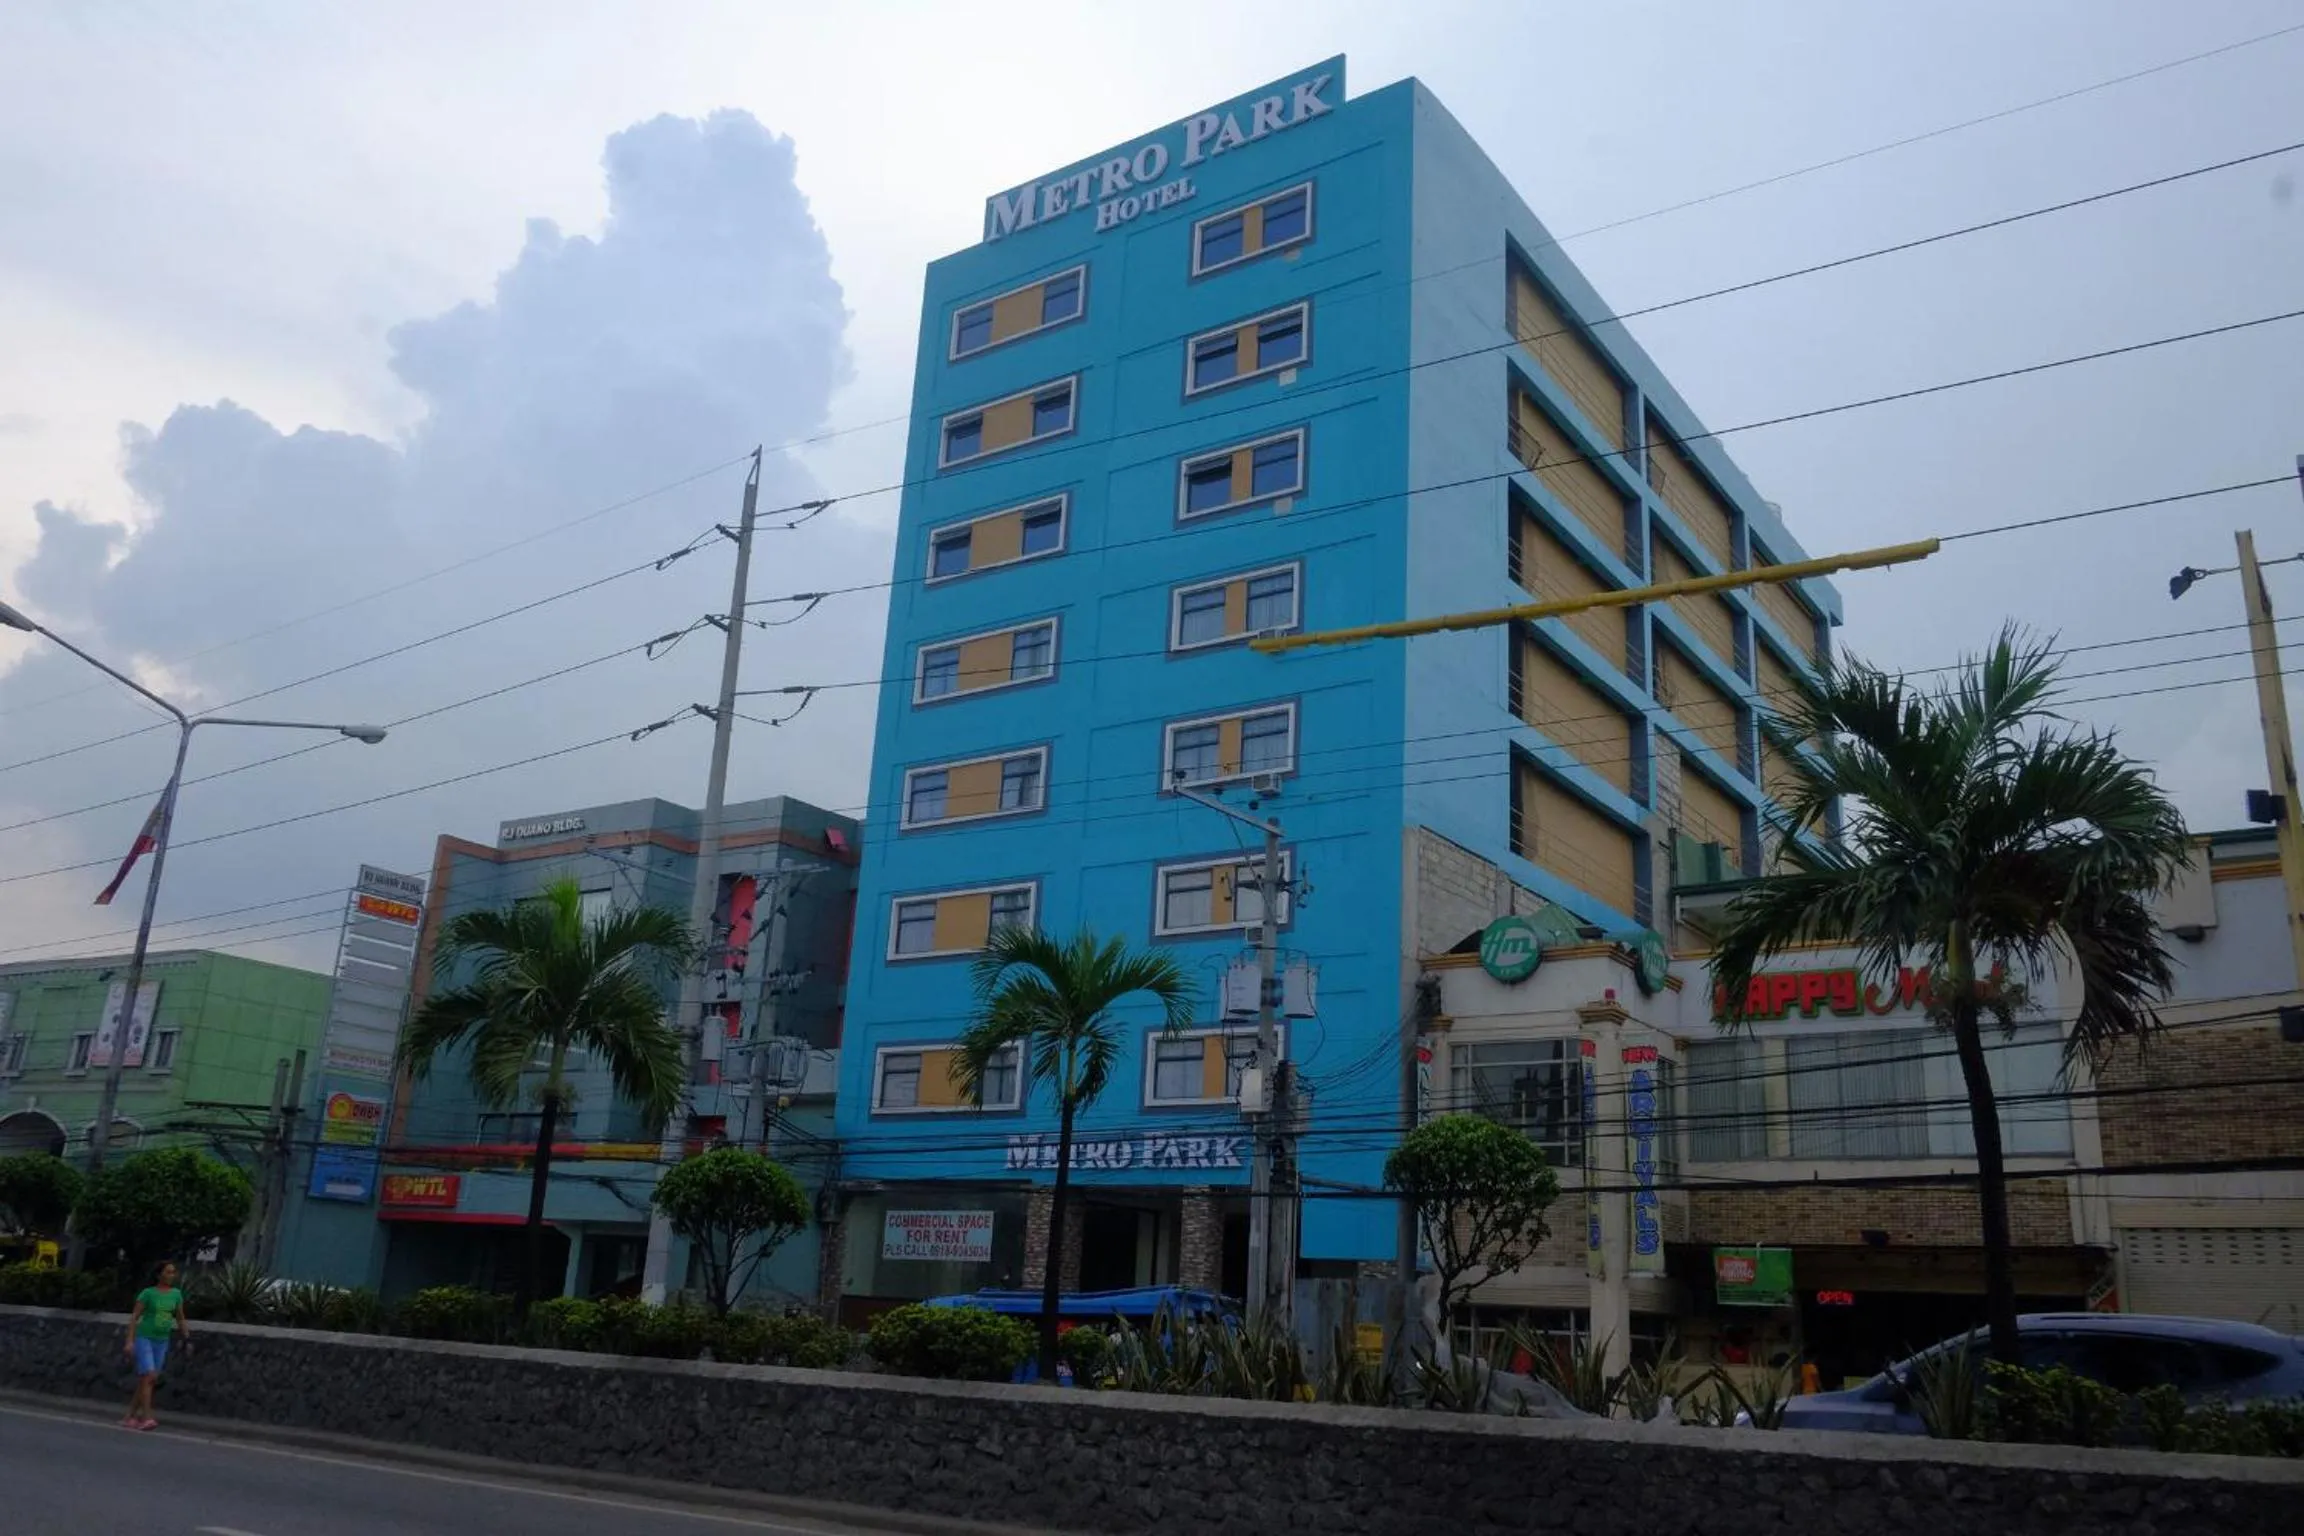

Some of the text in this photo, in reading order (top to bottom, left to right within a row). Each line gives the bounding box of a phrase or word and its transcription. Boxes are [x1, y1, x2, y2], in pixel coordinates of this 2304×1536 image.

[987, 74, 1334, 242] METRO PARK
[1095, 178, 1197, 233] HOTEL
[1622, 1047, 1658, 1064] NEW
[1006, 1131, 1243, 1169] METRO PARK
[1628, 1069, 1660, 1255] ARRIVALS
[888, 1214, 991, 1229] COMMERCIAL SPACE
[906, 1230, 968, 1243] FOR RENT
[1816, 1290, 1854, 1305] OPEN
